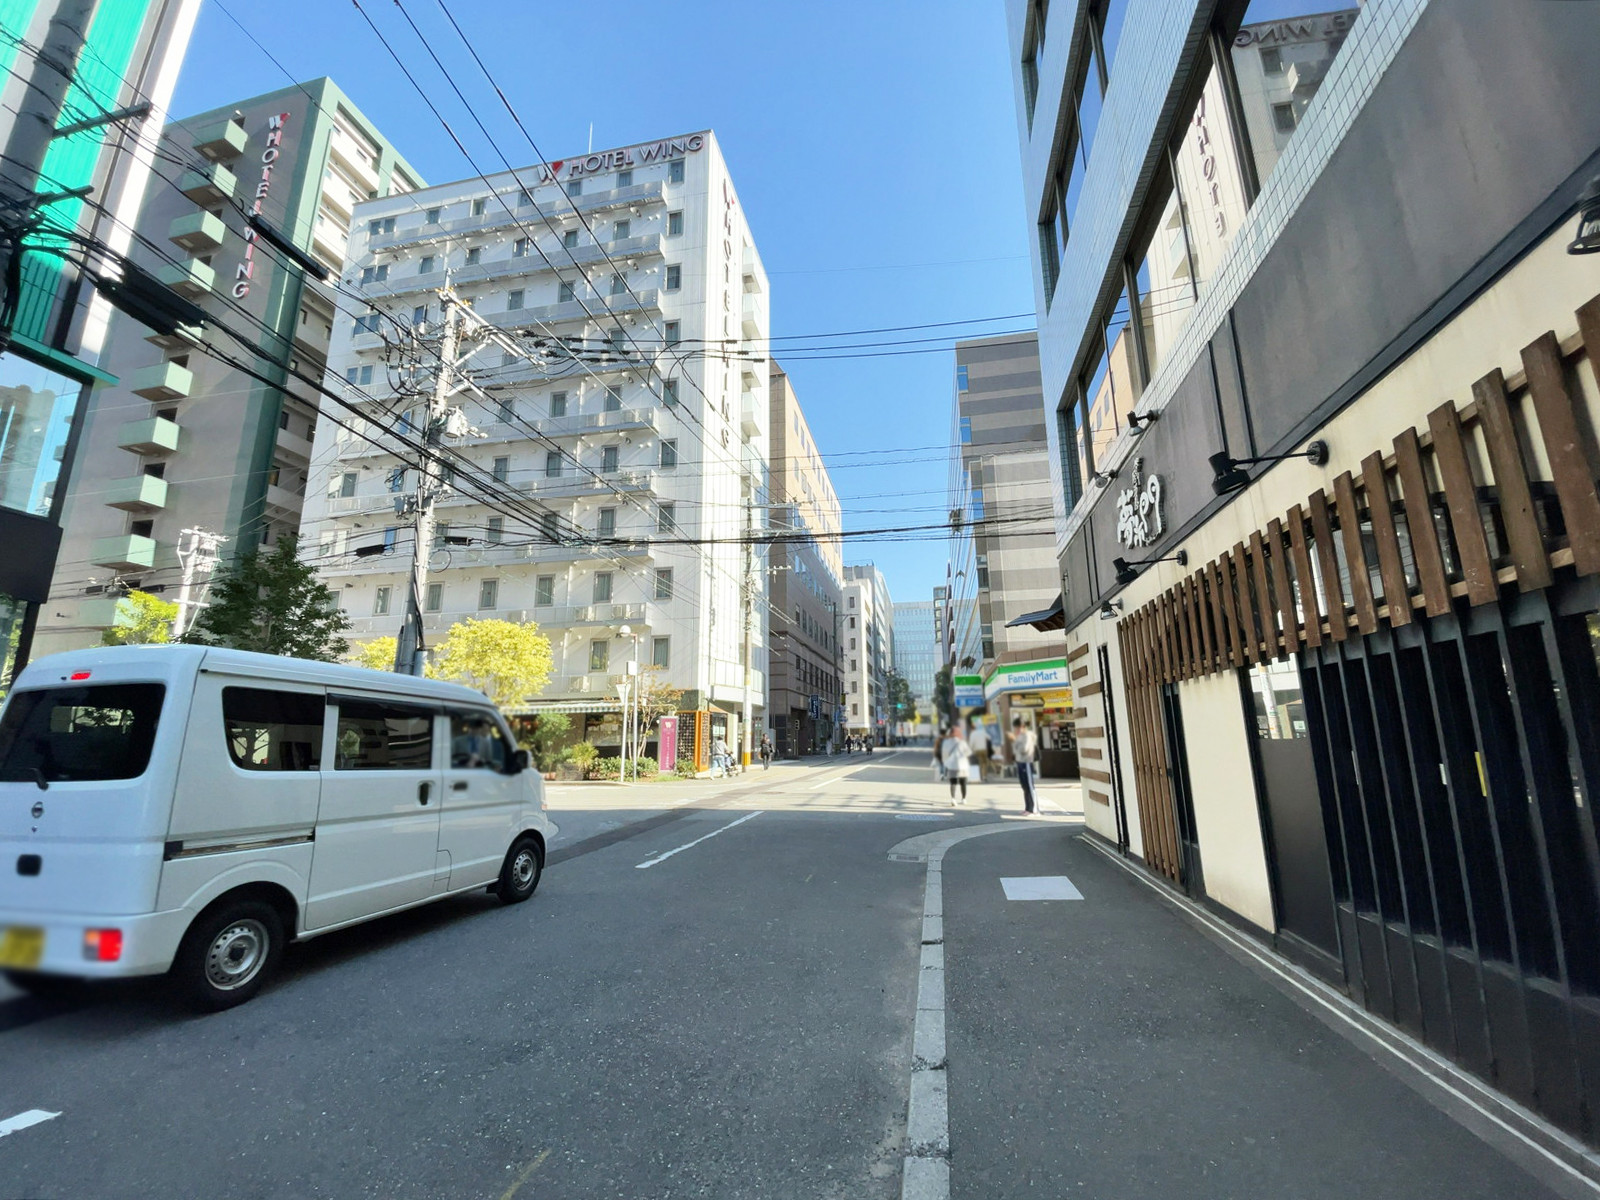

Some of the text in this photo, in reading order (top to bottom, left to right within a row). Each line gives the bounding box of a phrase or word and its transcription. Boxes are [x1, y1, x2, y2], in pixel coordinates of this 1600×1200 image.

[249, 130, 283, 218] HOTEL
[569, 149, 634, 177] HOTEL
[639, 134, 705, 161] WING
[232, 226, 260, 299] WING
[1007, 670, 1059, 685] FamilyMart
